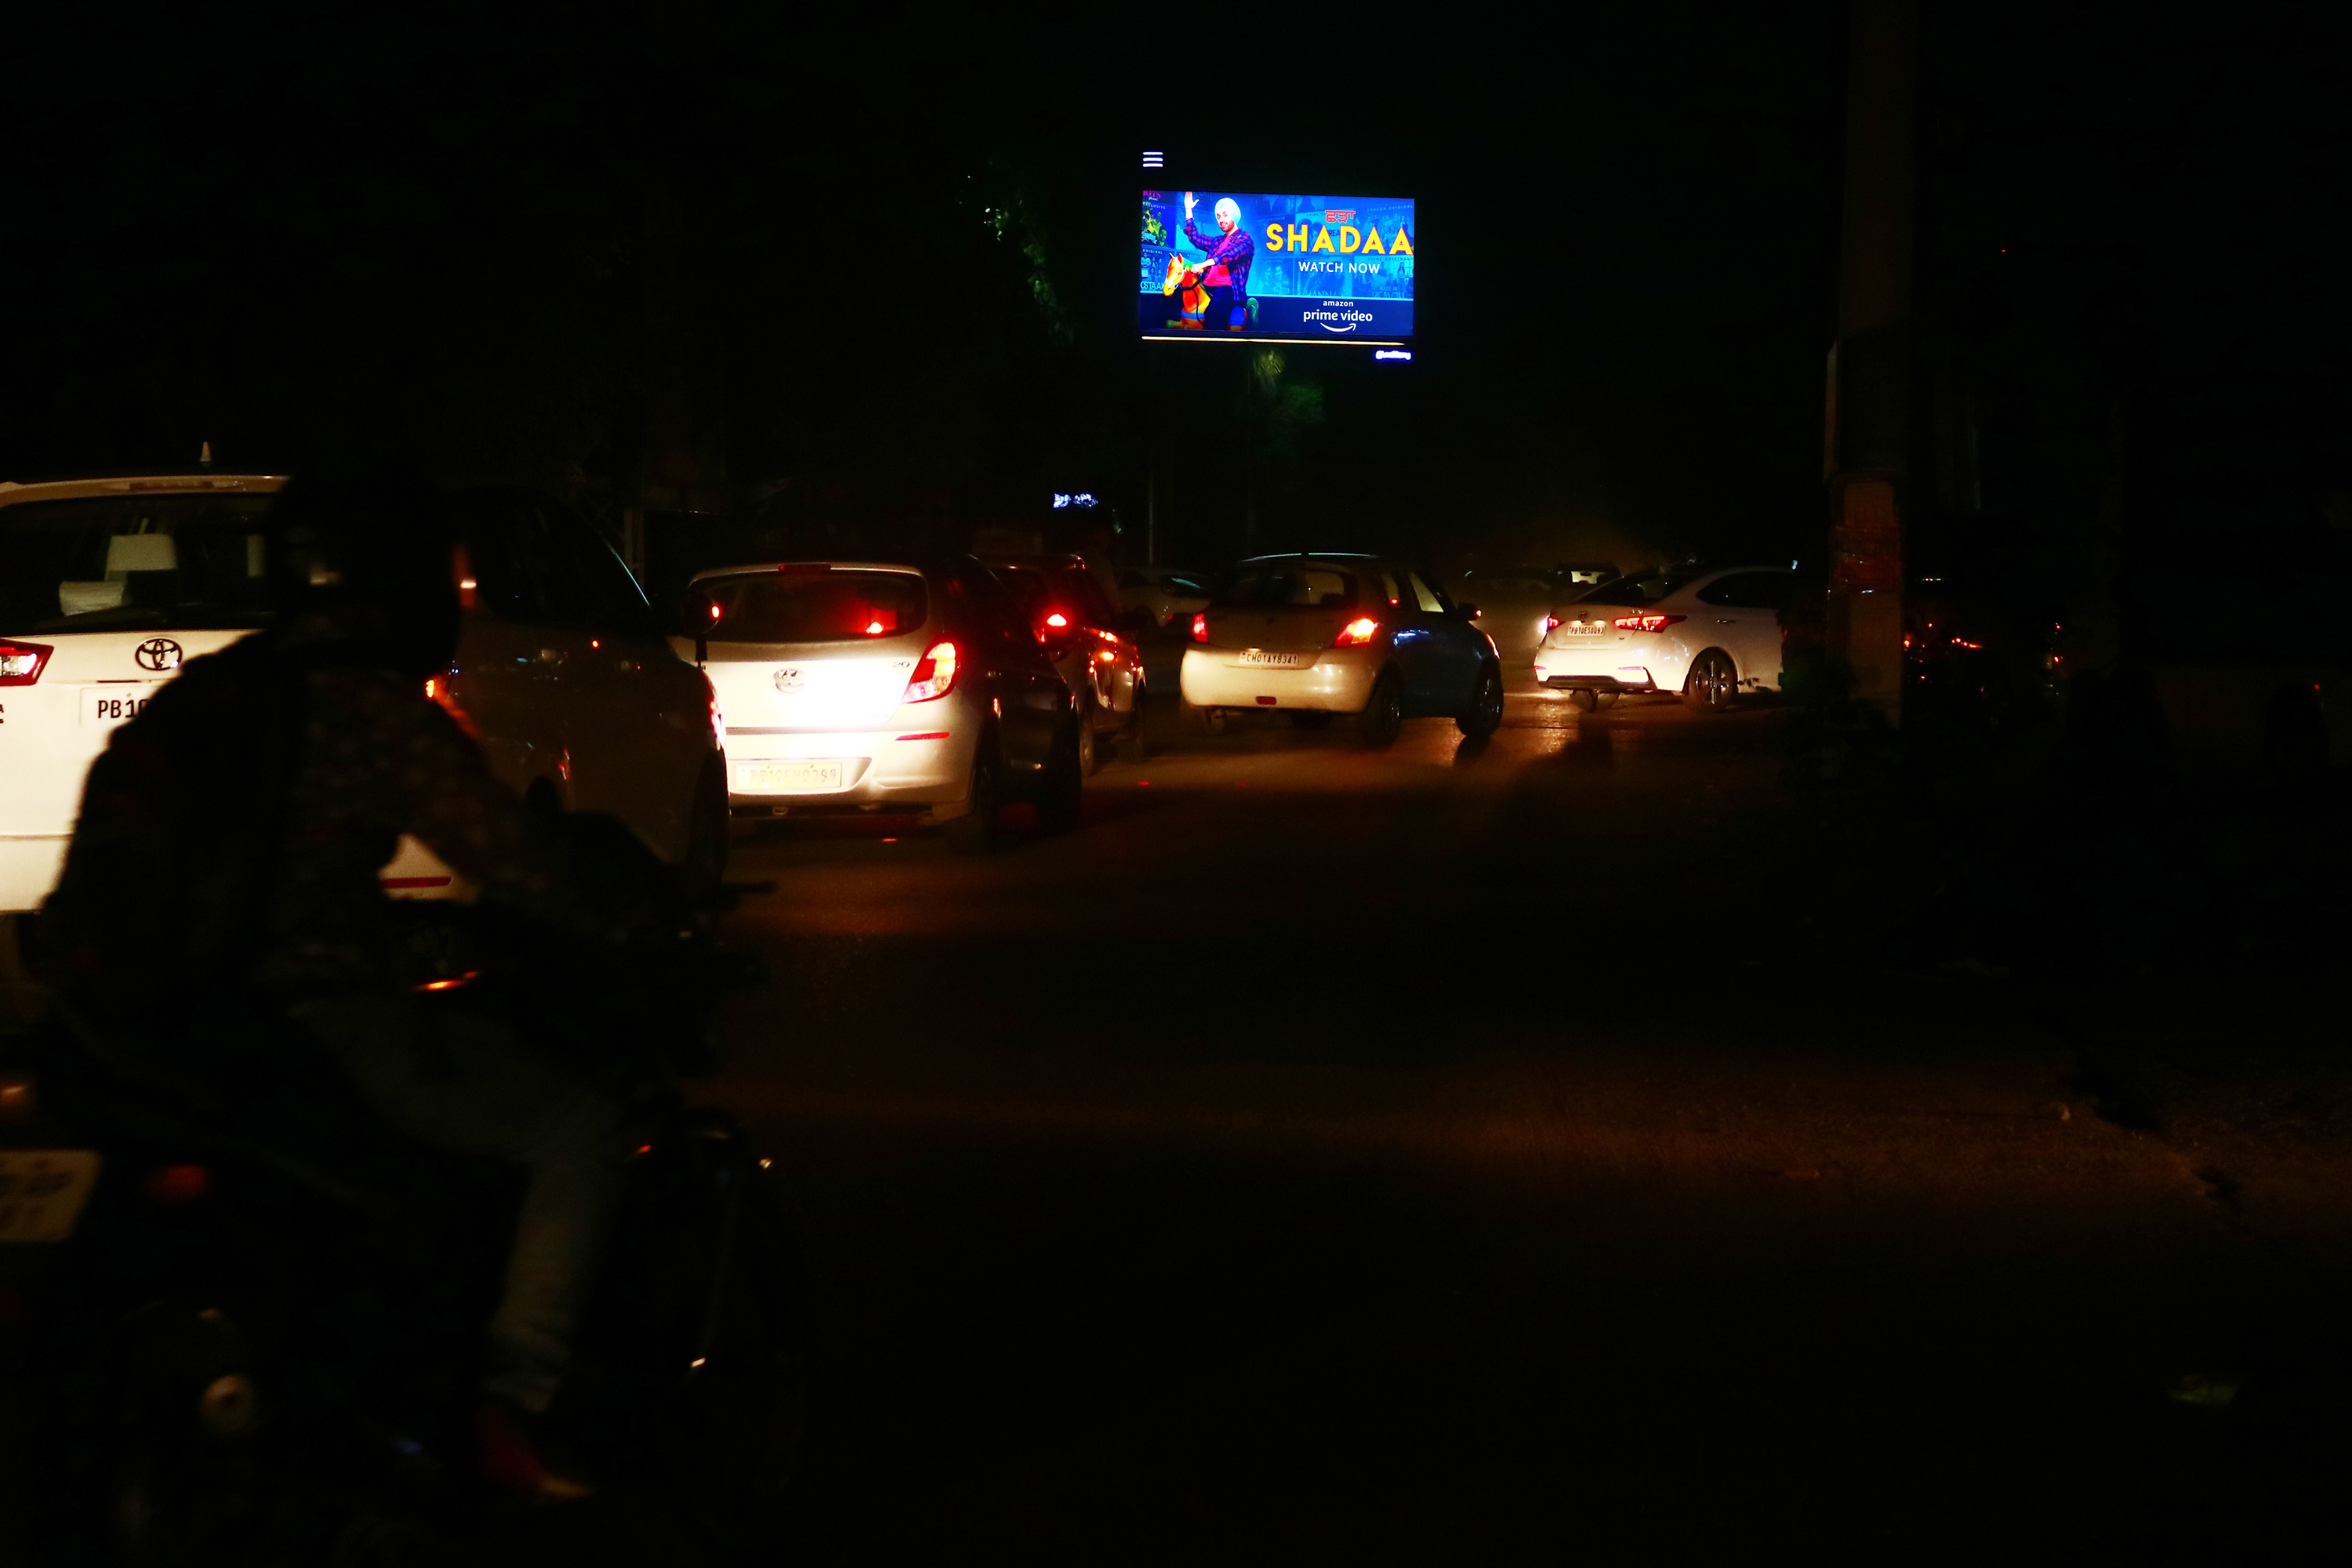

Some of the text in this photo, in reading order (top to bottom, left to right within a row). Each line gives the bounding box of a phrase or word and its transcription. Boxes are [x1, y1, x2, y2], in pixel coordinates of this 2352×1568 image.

[1265, 223, 1414, 255] SHADAA
[1298, 261, 1380, 274] WATCH NOW
[1303, 308, 1373, 322] prime video
